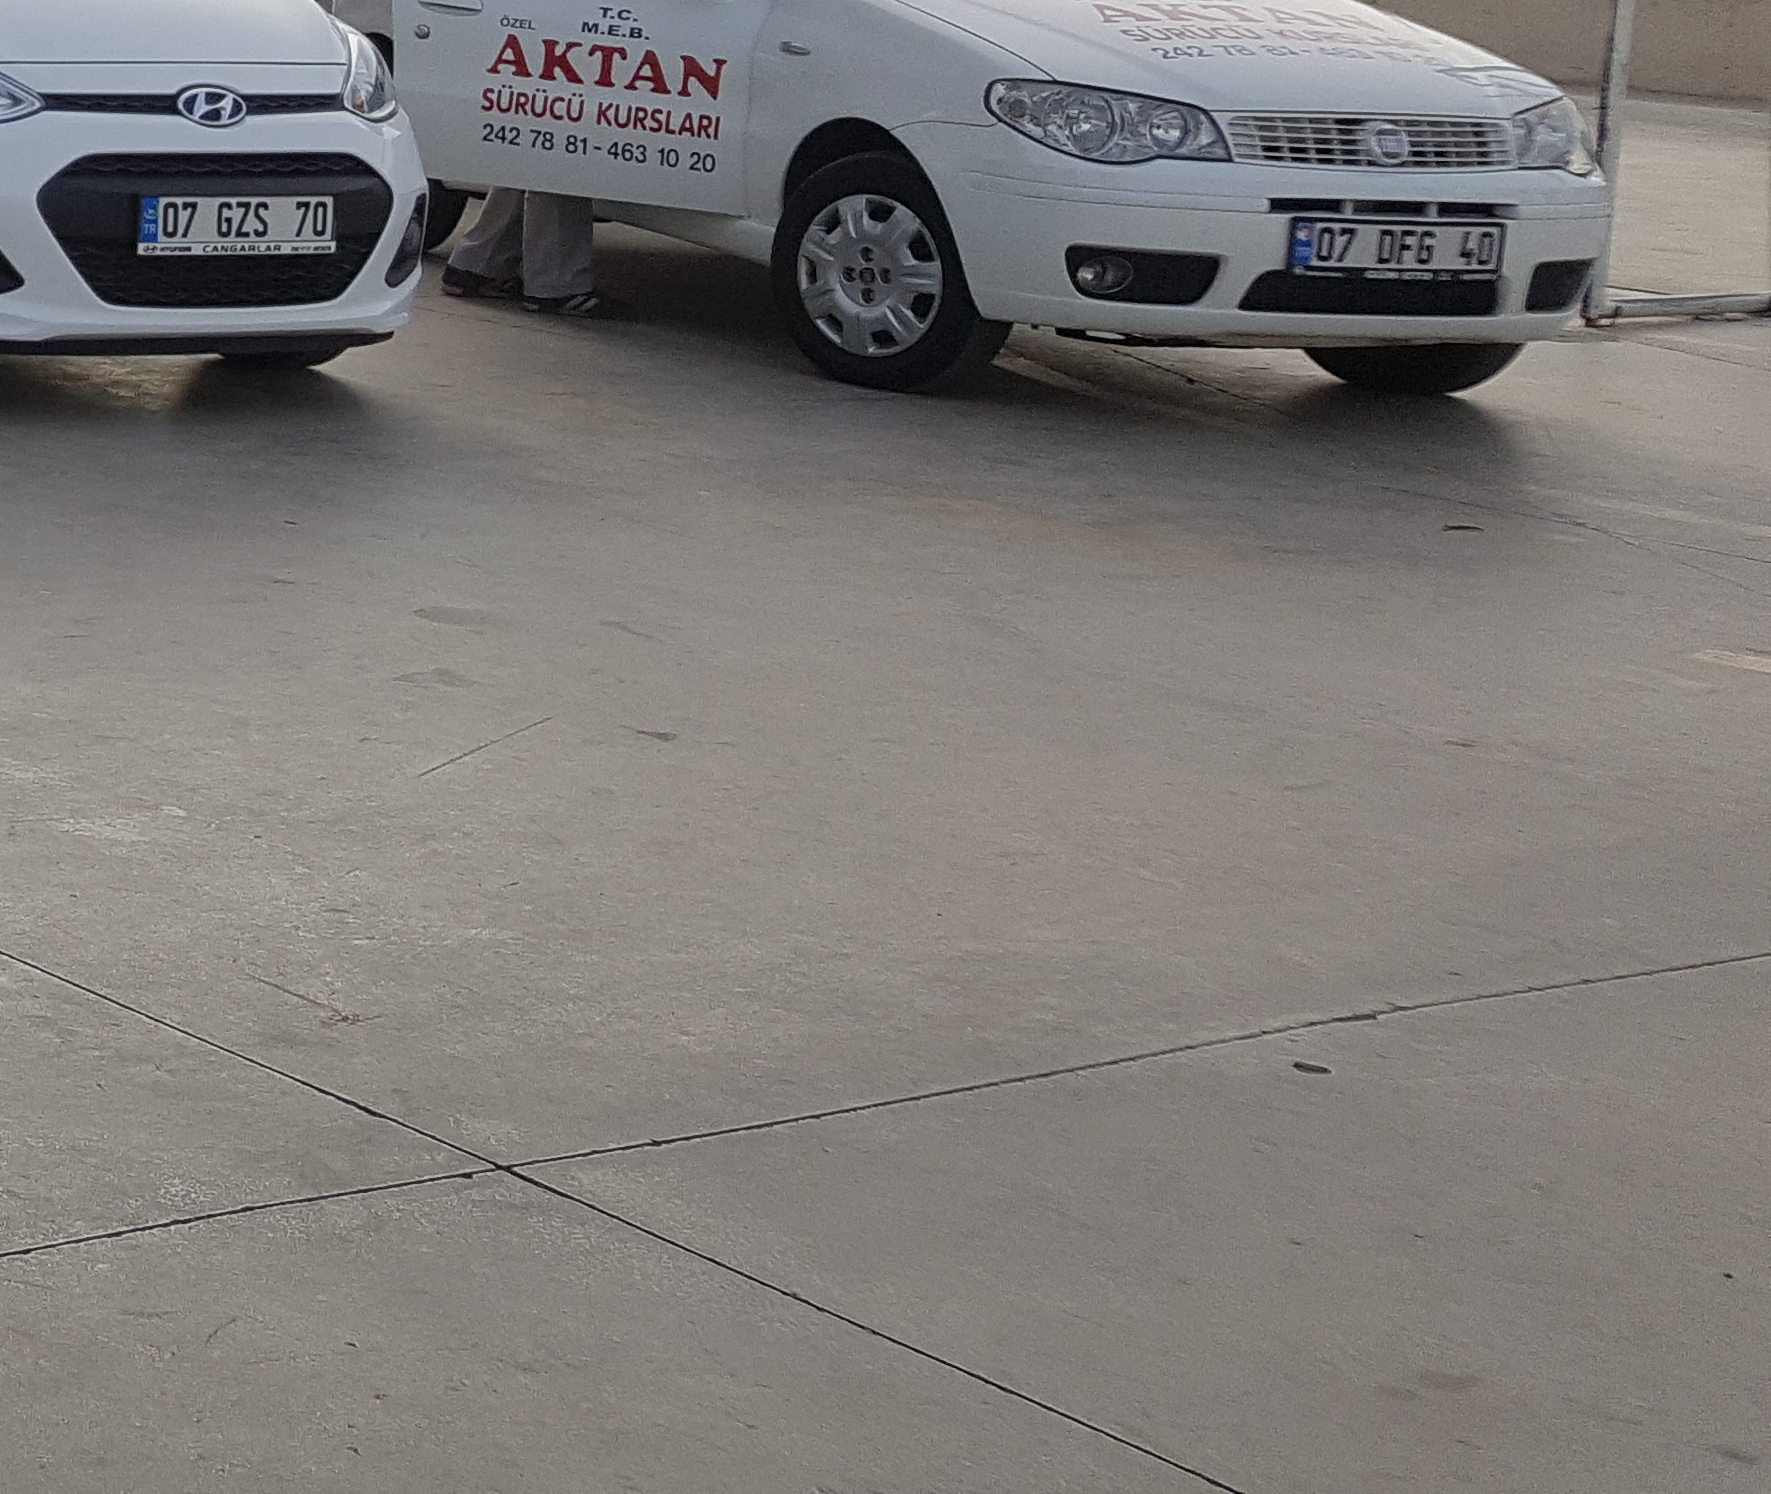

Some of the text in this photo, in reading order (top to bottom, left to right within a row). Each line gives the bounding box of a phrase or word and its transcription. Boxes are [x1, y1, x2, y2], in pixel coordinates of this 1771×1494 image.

[499, 14, 537, 31] ÖZEL
[598, 6, 640, 23] T.C.
[581, 21, 651, 41] M.E.B.
[485, 33, 728, 101] AKTAN
[480, 83, 722, 141] SÜRÜCÜ KURSLARI
[481, 123, 522, 147] 242
[528, 128, 555, 151] 78
[657, 147, 681, 169] 10
[688, 151, 717, 174] 20
[143, 223, 157, 235] TR
[161, 200, 329, 239] 07 GZS 70
[202, 244, 282, 254] CANGARLAR
[1316, 226, 1359, 263] 07
[1459, 230, 1496, 266] 40
